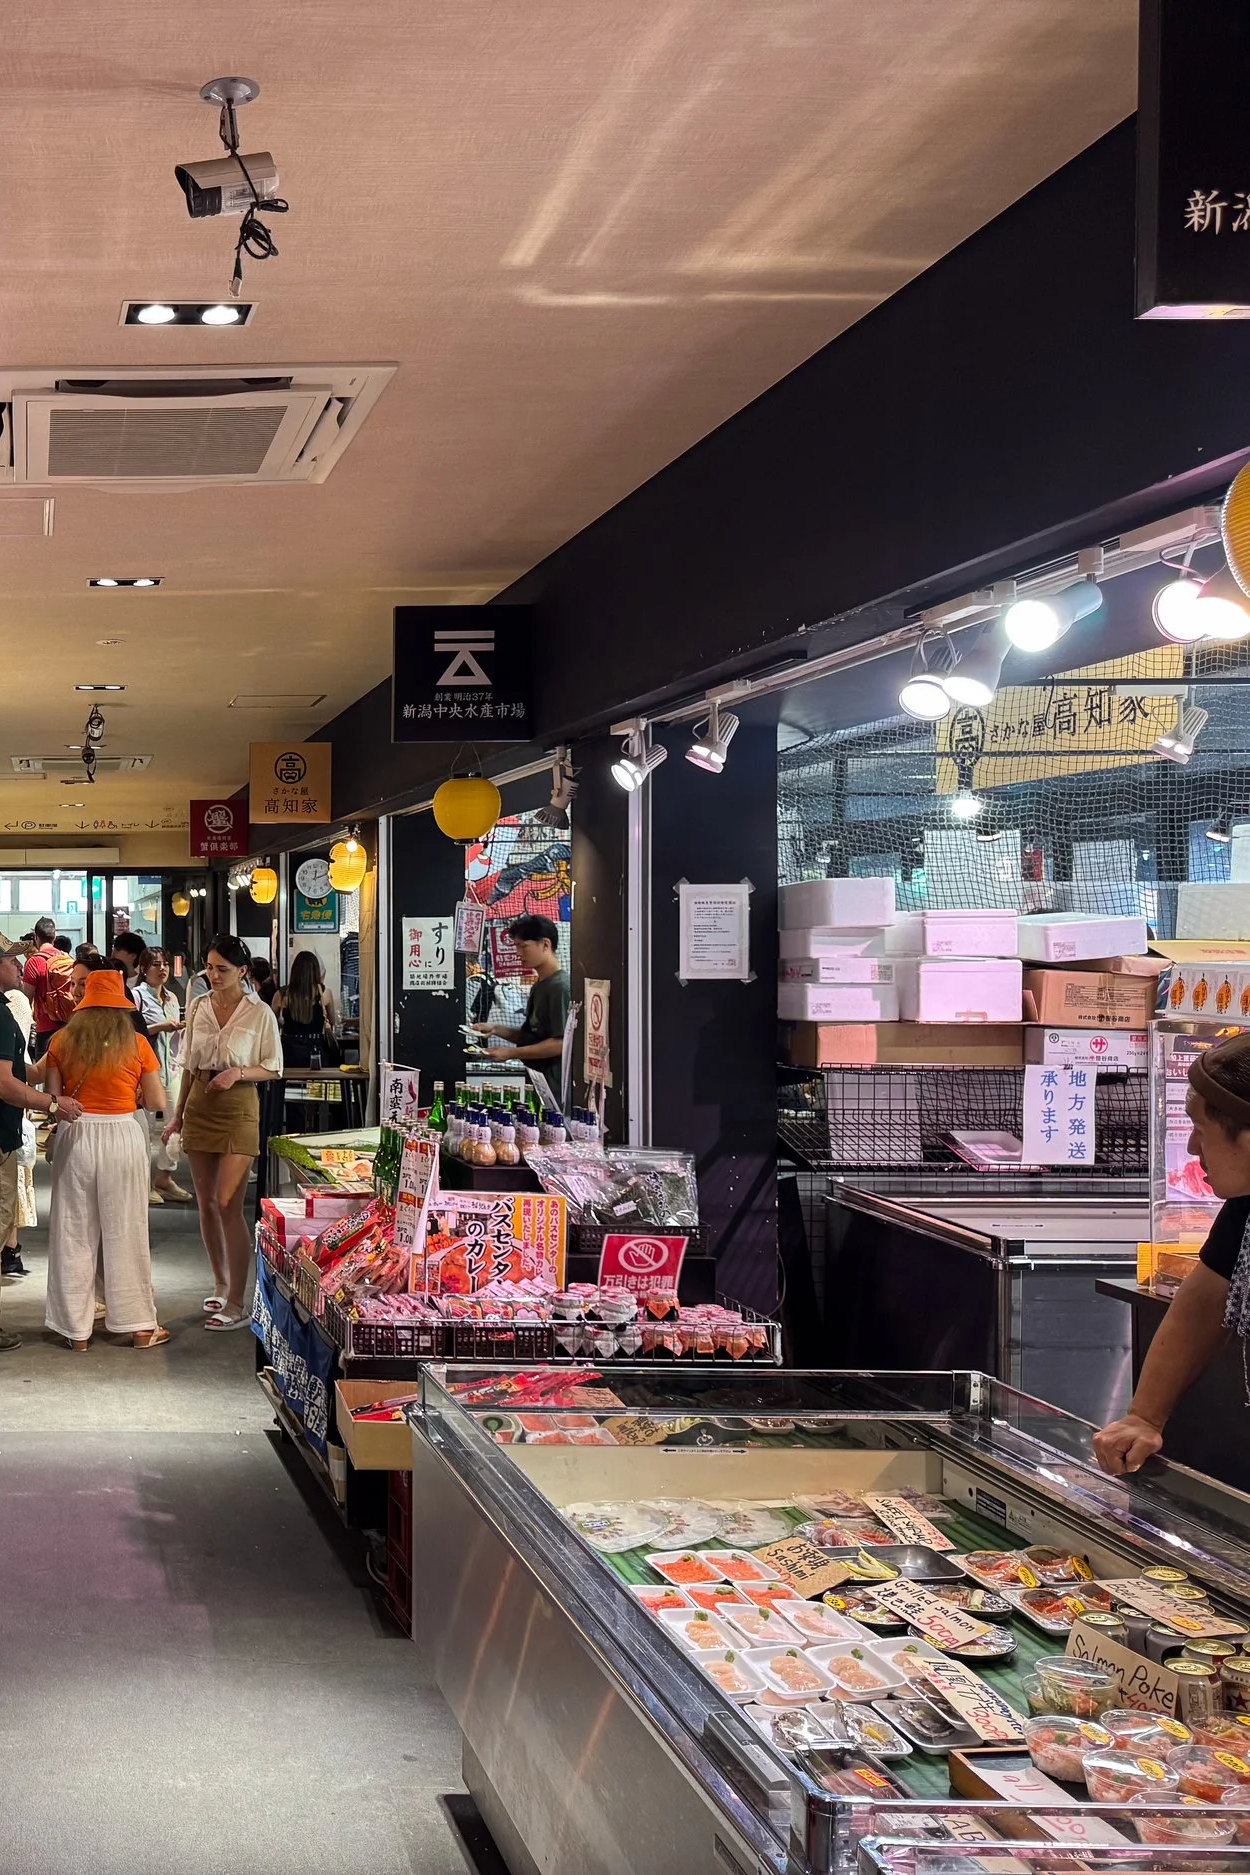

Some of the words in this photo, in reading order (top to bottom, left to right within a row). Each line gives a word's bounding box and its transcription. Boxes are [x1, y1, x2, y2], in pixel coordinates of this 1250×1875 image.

[402, 703, 526, 719] 新潟中央水産市場
[454, 692, 494, 701] 明治37年
[264, 798, 317, 814] 高知家
[272, 787, 309, 796] さかな屋
[301, 910, 332, 920] 宅急便
[408, 928, 423, 968] 御用心
[432, 922, 449, 966] すり
[1166, 1067, 1188, 1078] おいし
[389, 1078, 404, 1125] 南蛮え
[1040, 1070, 1059, 1144] 承ります
[1068, 1070, 1087, 1160] 地方発送
[465, 1221, 486, 1293] のカレー
[490, 1197, 515, 1285] バスセンタ
[521, 1198, 533, 1272] 再現いたしました。
[535, 1199, 546, 1277] オリジナル名物カレ
[549, 1199, 560, 1275] あのバスセンターの
[603, 1275, 675, 1290] 万引きは犯罪
[767, 1549, 816, 1580] Sashimi
[894, 1580, 936, 1606] Grilled
[935, 1603, 975, 1632] salmon
[1128, 1665, 1175, 1709] Poke
